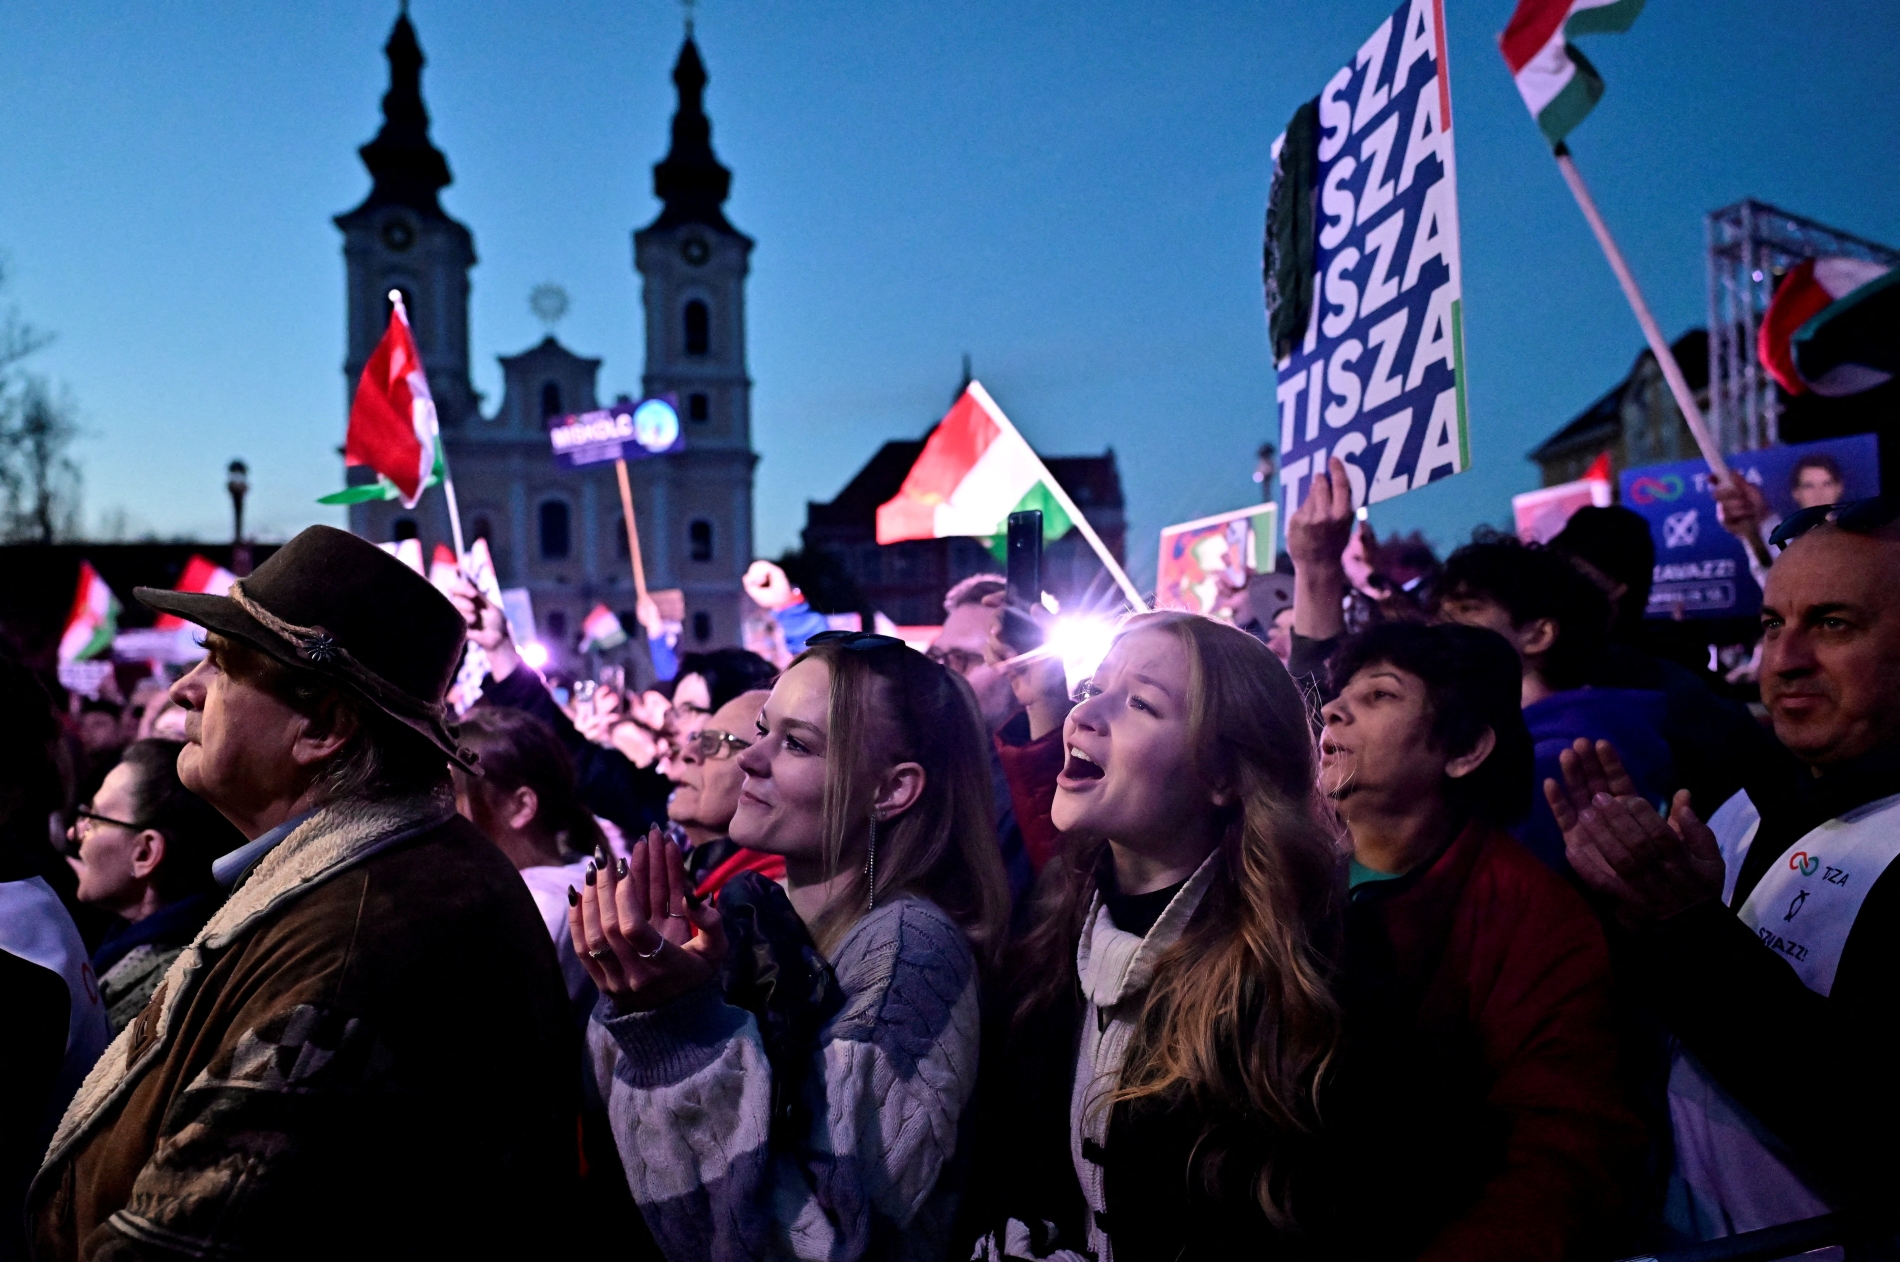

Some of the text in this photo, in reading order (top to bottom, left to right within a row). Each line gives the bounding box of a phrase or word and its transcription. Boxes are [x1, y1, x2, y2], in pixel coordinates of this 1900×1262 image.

[1318, 0, 1438, 162] SZA
[1319, 74, 1445, 250] SZA
[1279, 185, 1450, 372] ISZA
[1276, 285, 1456, 455] TISZA
